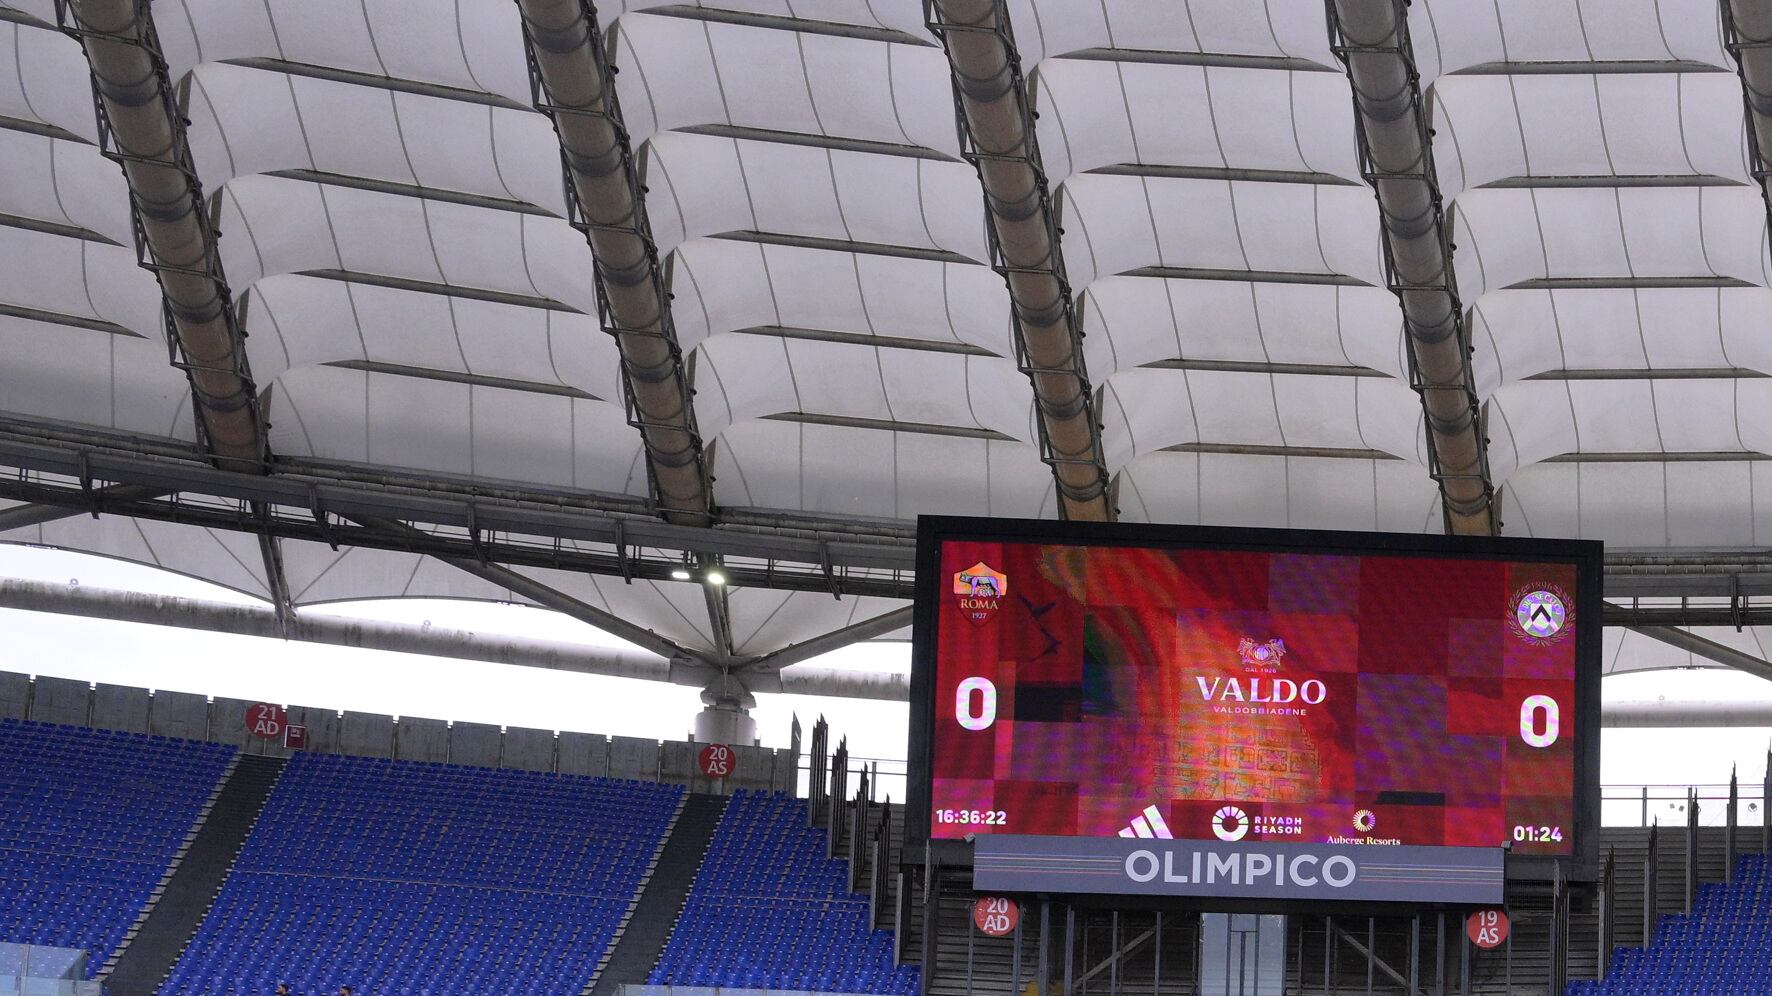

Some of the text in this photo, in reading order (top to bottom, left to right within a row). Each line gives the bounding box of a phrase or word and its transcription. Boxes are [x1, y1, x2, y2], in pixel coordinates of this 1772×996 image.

[961, 599, 998, 610] ROMA
[1196, 676, 1327, 705] VALDO
[956, 677, 997, 731] 0
[1213, 706, 1307, 716] VALDOBBIADENE
[257, 705, 277, 720] 21
[254, 720, 279, 735] AD
[1520, 694, 1560, 748] 0
[709, 747, 728, 760] 20
[707, 761, 728, 775] AS
[936, 809, 1007, 825] 16:36:22
[1254, 816, 1302, 825] RIYADH
[1254, 825, 1302, 834] SEASON
[1513, 825, 1563, 843] 01:24
[1326, 835, 1401, 846] Auberge Resorts
[1125, 849, 1357, 888] OLIMPICO
[986, 897, 1009, 914] 20
[983, 914, 1010, 931] AD
[1478, 910, 1498, 926] 19
[1477, 928, 1500, 944] AS
